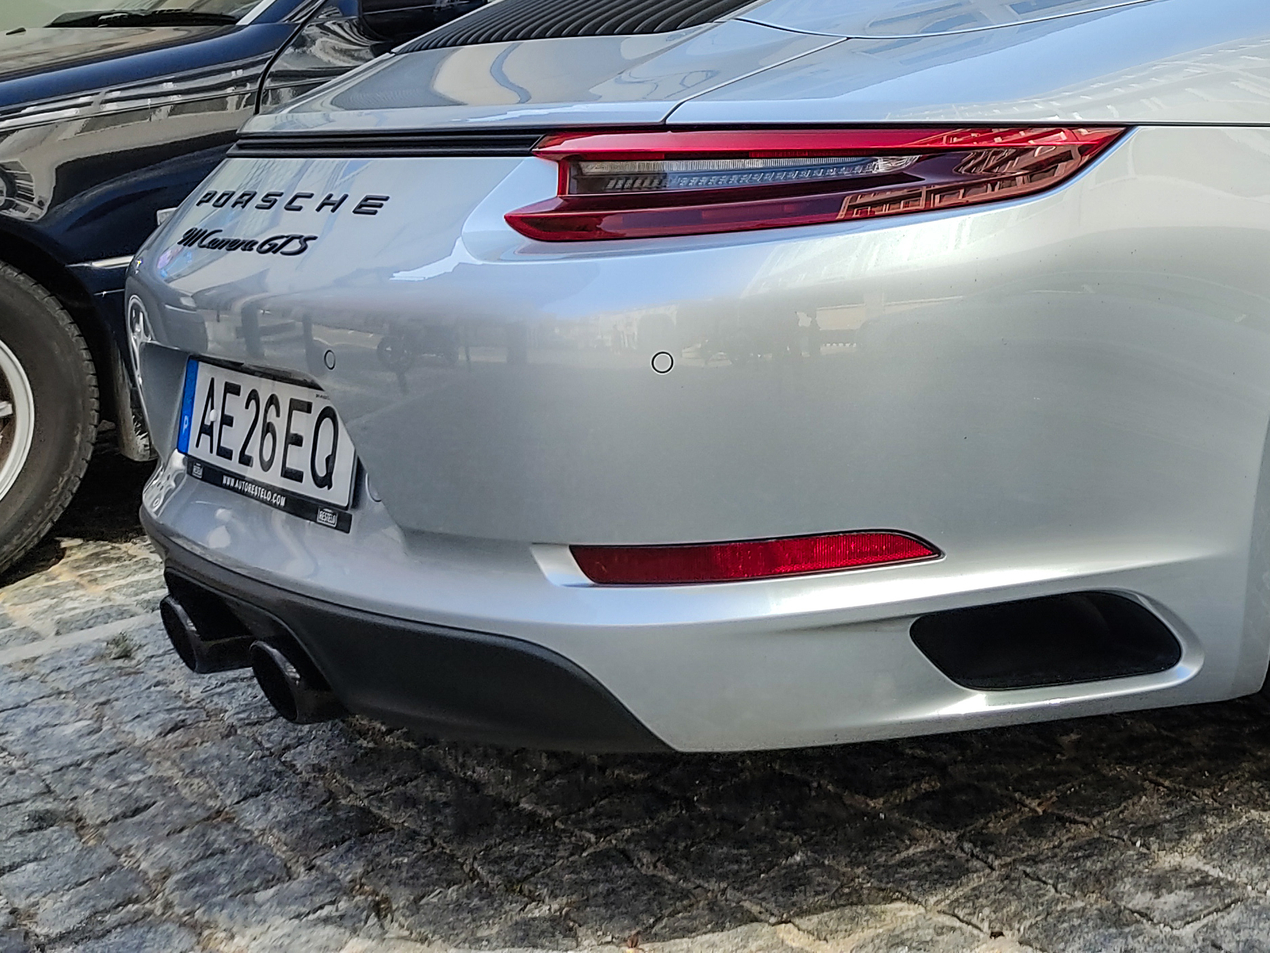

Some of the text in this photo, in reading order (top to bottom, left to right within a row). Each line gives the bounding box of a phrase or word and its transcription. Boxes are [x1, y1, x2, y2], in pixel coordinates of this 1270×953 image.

[196, 190, 390, 215] PORSCHE
[177, 227, 318, 256] 911 Carrera GTS
[182, 416, 189, 434] P
[222, 475, 286, 507] WWW.AUTORESTELO.COM
